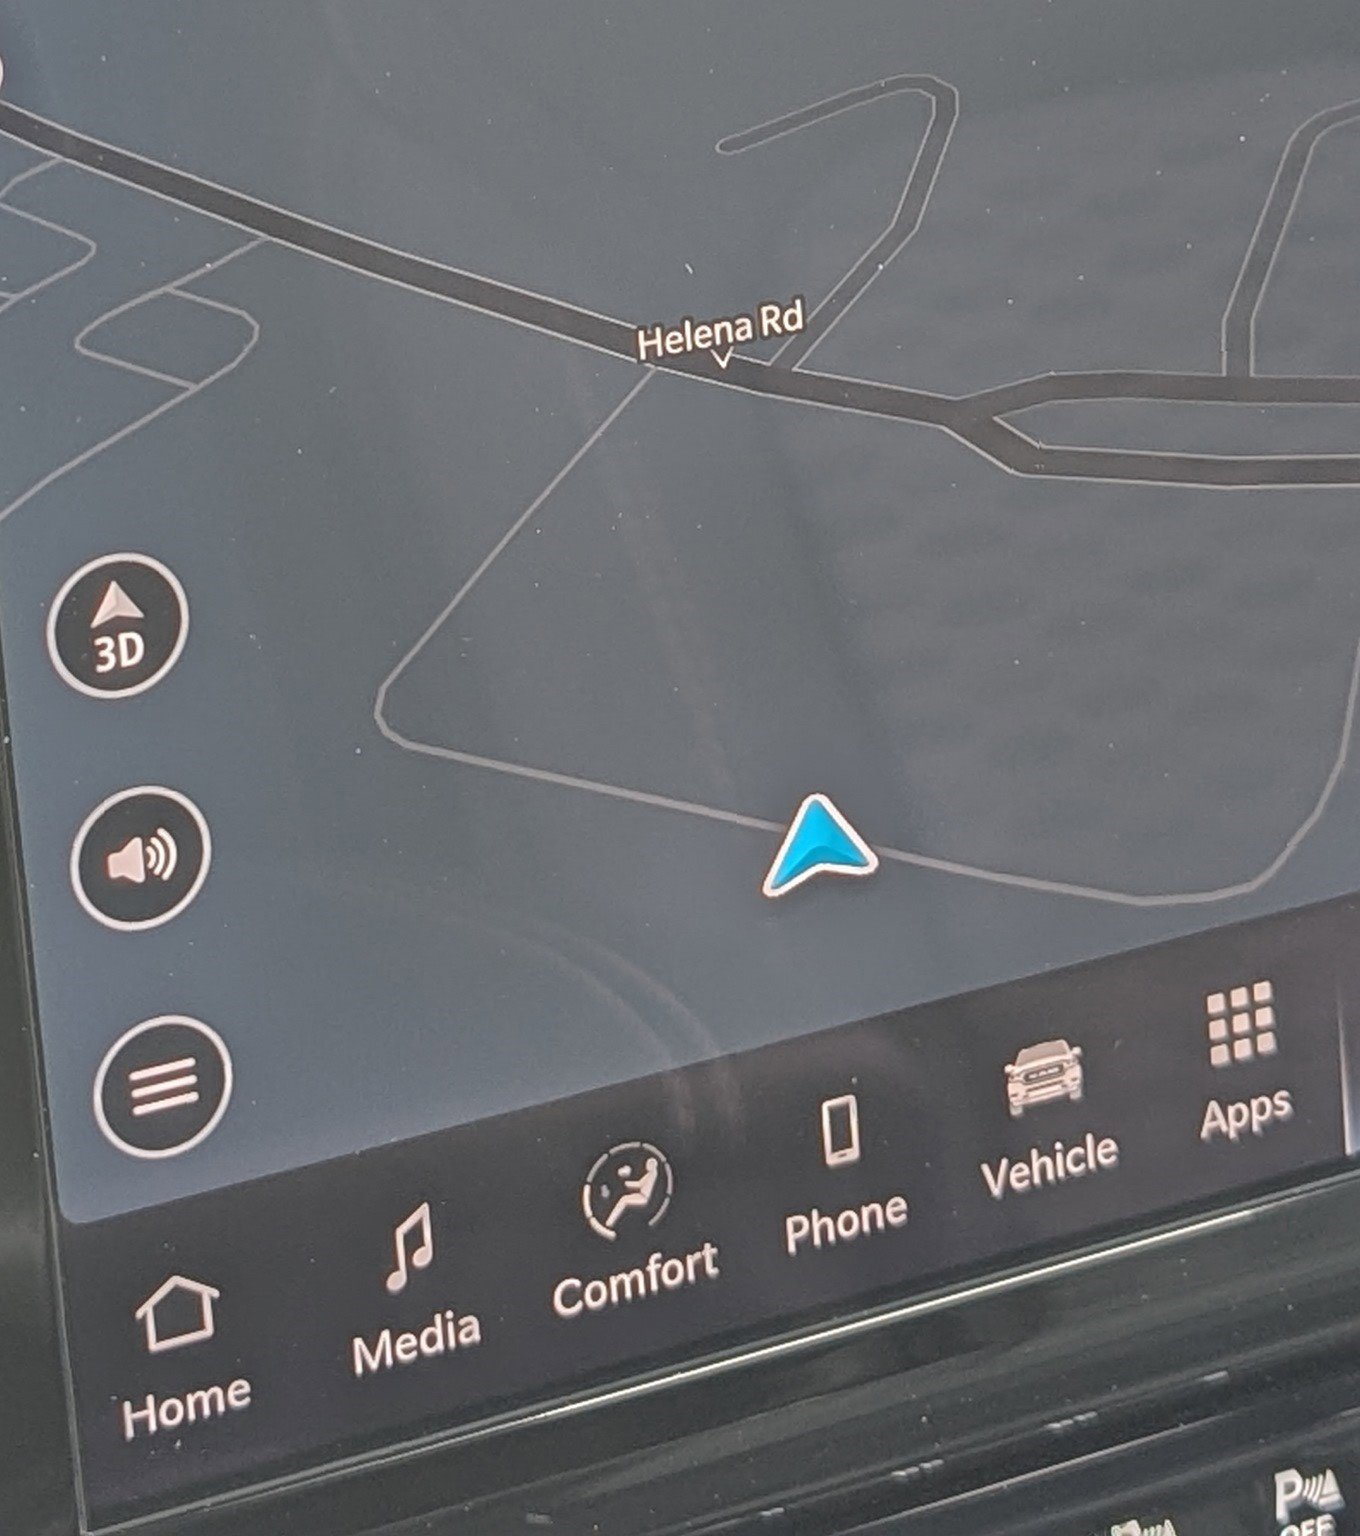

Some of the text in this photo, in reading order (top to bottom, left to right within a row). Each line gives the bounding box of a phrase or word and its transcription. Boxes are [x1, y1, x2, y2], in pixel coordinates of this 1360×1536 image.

[638, 298, 803, 361] Helena Rd
[94, 631, 145, 673] 3D
[1200, 1090, 1293, 1140] Apps
[981, 1132, 1119, 1198] Vehicle
[786, 1196, 908, 1254] Phone
[553, 1242, 719, 1317] Comfort
[353, 1309, 481, 1376] Media
[123, 1379, 251, 1440] Home
